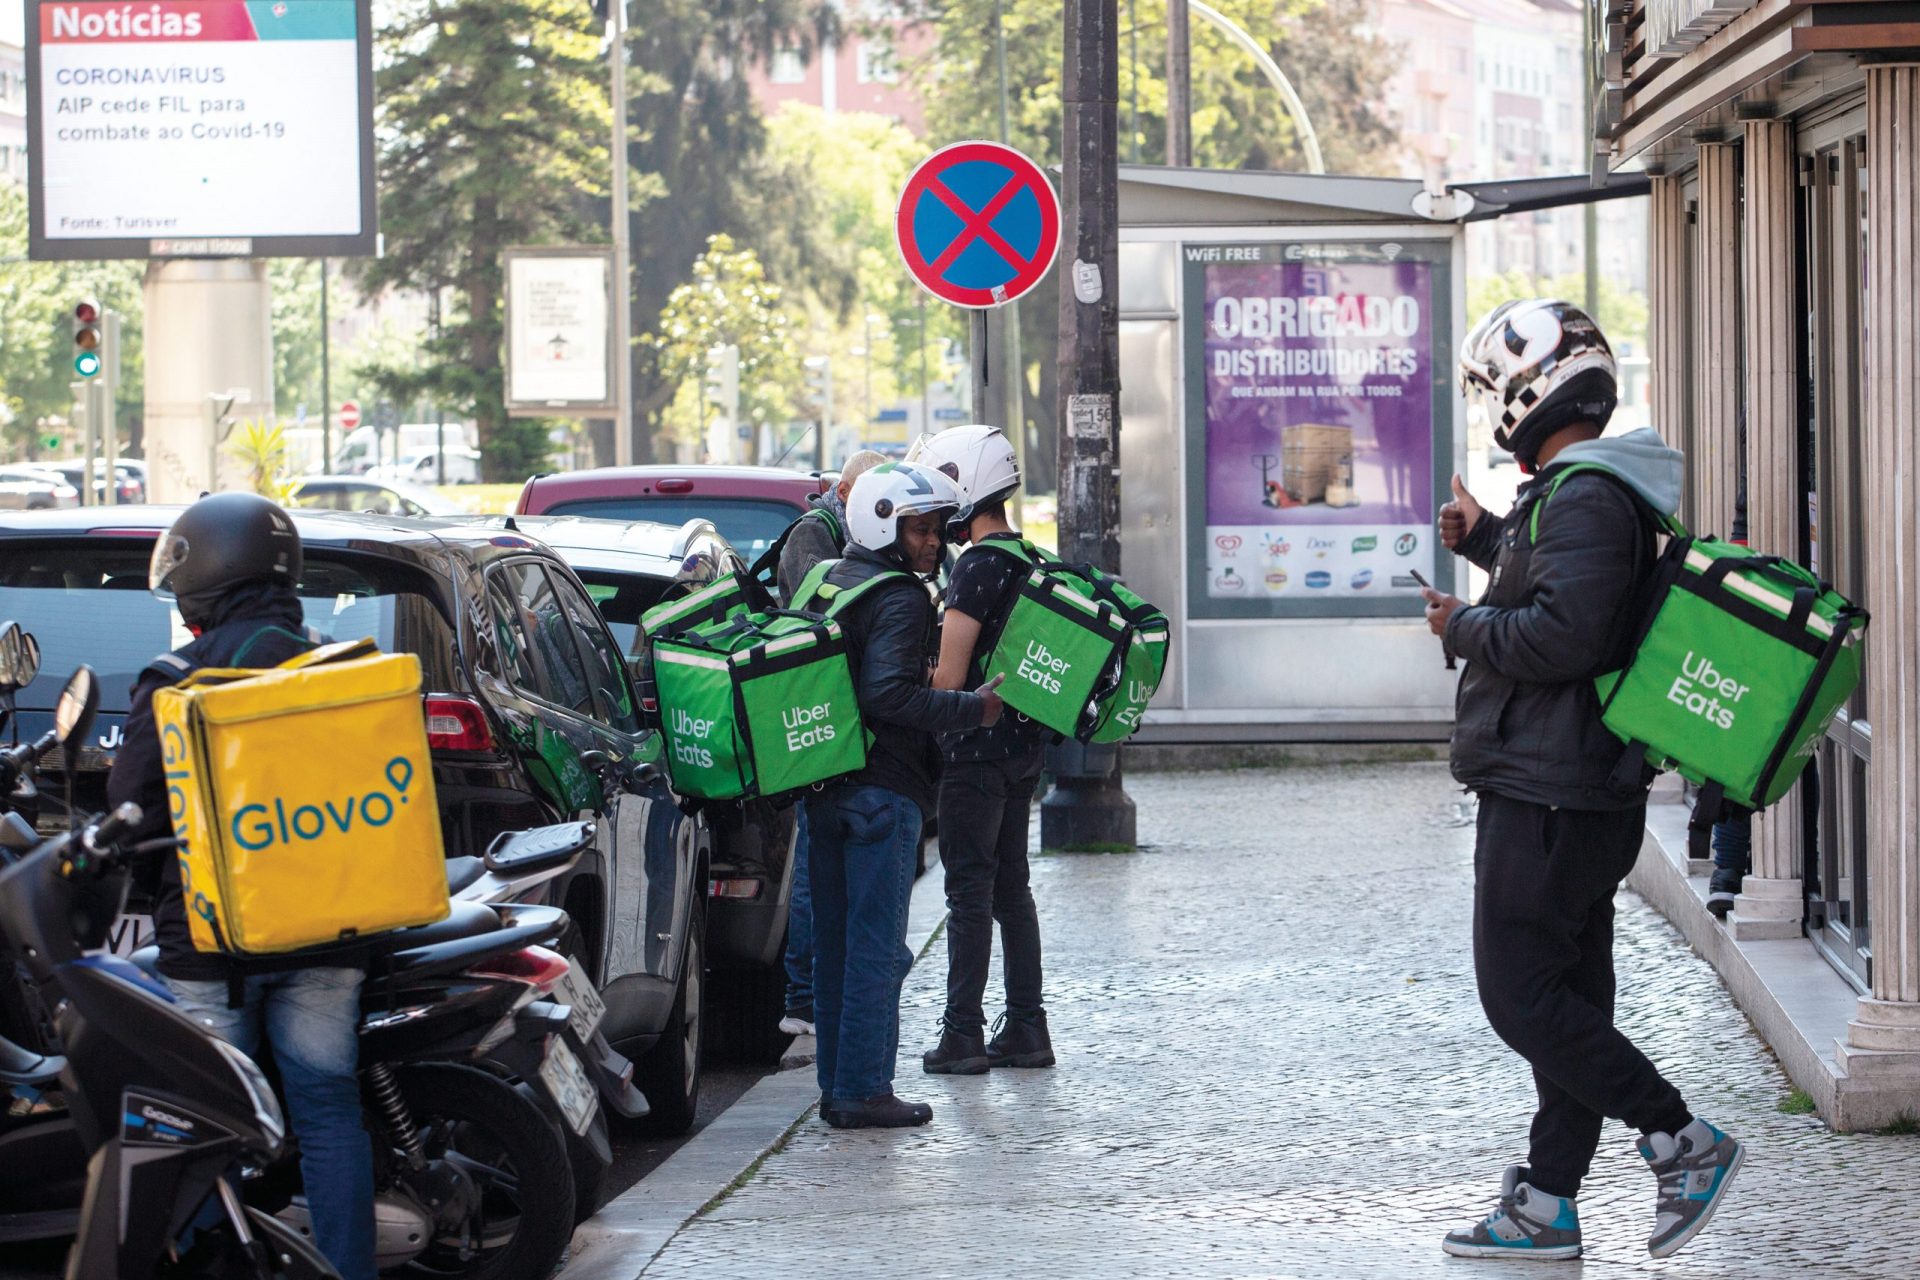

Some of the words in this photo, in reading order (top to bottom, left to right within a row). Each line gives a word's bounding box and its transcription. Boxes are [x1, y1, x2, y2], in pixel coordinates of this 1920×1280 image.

[53, 5, 202, 37] Notícias
[56, 63, 226, 86] CORONAVÍRUS
[57, 97, 93, 114] AIP
[101, 96, 151, 113] cede
[159, 96, 191, 112] FIL
[200, 100, 246, 115] para
[58, 125, 150, 141] combate
[158, 128, 183, 140] ao
[191, 122, 286, 140] Covid-19
[60, 217, 109, 230] Fonte:
[1187, 247, 1221, 261] WiFi
[1226, 247, 1261, 261] FREE
[1214, 295, 1420, 339] OBRIGADO
[1214, 348, 1418, 377] DISTRIBUIDORES
[1232, 386, 1253, 398] QUE
[1256, 386, 1295, 397] ANDAM
[1299, 386, 1314, 397] NA
[1317, 386, 1340, 397] RUA
[1367, 385, 1402, 396] TODOS
[1027, 640, 1071, 675] Uber
[1016, 658, 1061, 694] Eats
[1681, 651, 1750, 702] Uber
[782, 702, 831, 729] Uber
[1667, 677, 1735, 729] Eats
[671, 708, 714, 739] Uber
[786, 723, 836, 752] Eats
[674, 737, 714, 768] Eats
